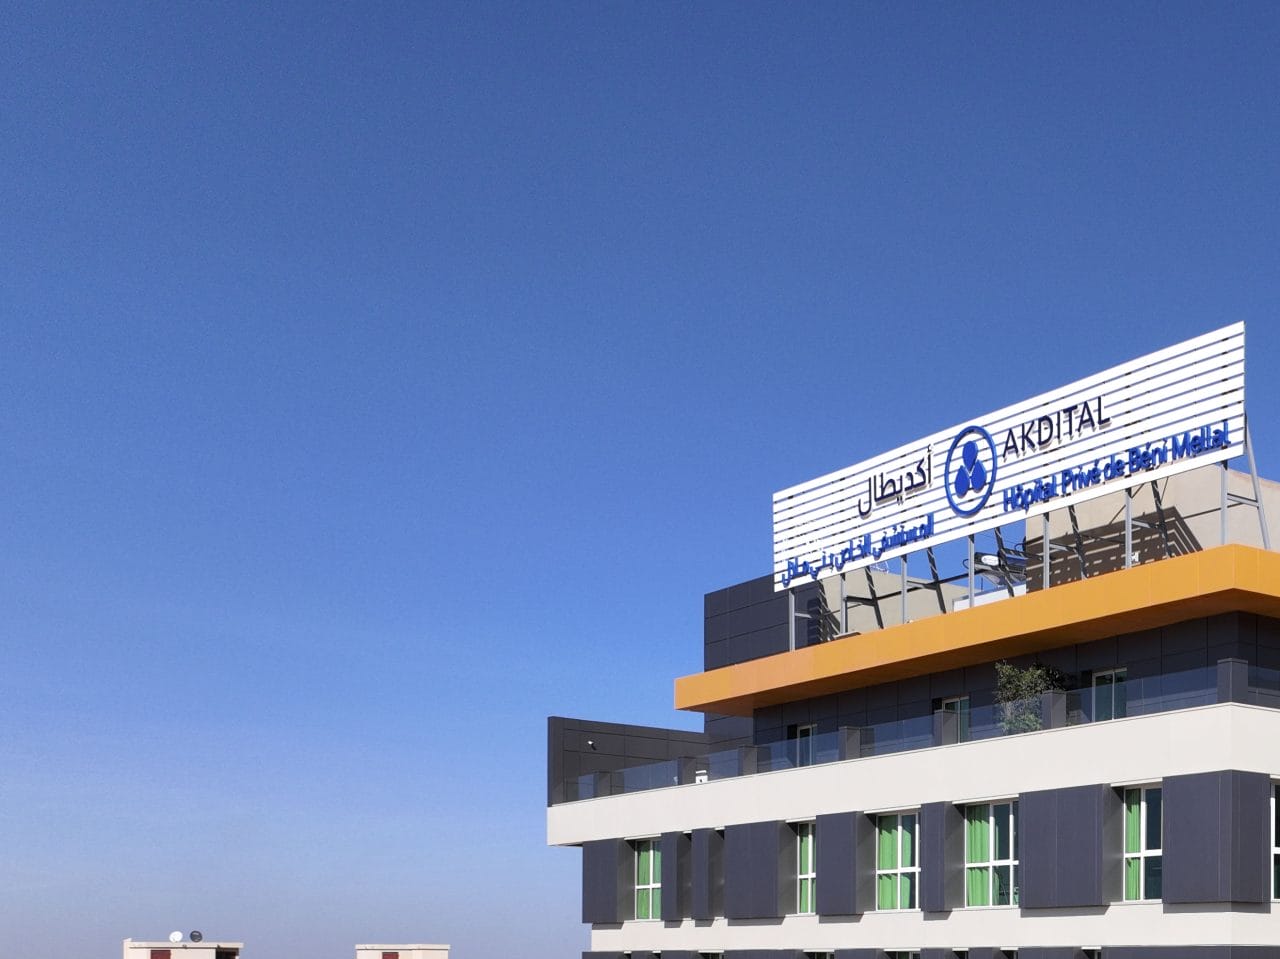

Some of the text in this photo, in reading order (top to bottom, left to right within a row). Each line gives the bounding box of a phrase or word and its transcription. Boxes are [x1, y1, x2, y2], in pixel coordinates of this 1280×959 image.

[1003, 396, 1111, 458] AKDITAL
[858, 444, 933, 517] أكديطال
[1002, 420, 1231, 513] Hôpital Privé de Béni Mellal
